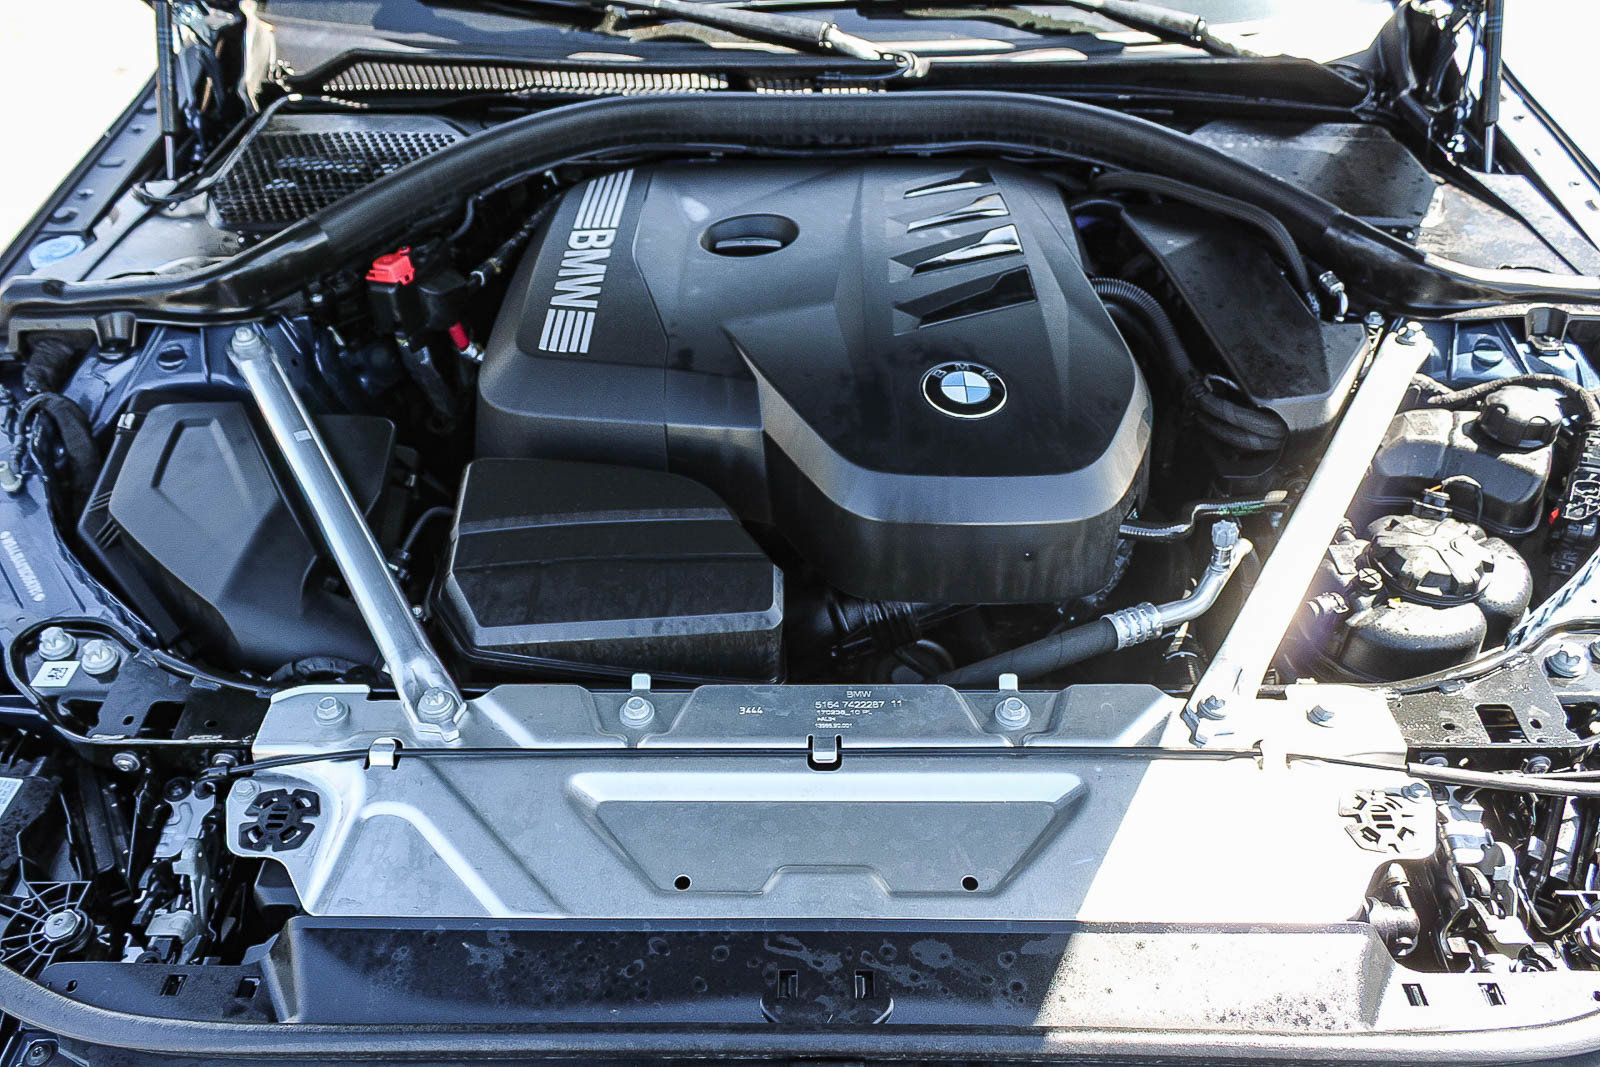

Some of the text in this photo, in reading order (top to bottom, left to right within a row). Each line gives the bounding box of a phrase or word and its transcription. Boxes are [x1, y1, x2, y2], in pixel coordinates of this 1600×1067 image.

[550, 229, 617, 309] BMW
[931, 363, 997, 380] BMW
[846, 690, 872, 698] BMW
[815, 701, 840, 709] 5164
[891, 700, 902, 708] 11
[739, 706, 763, 715] 3444
